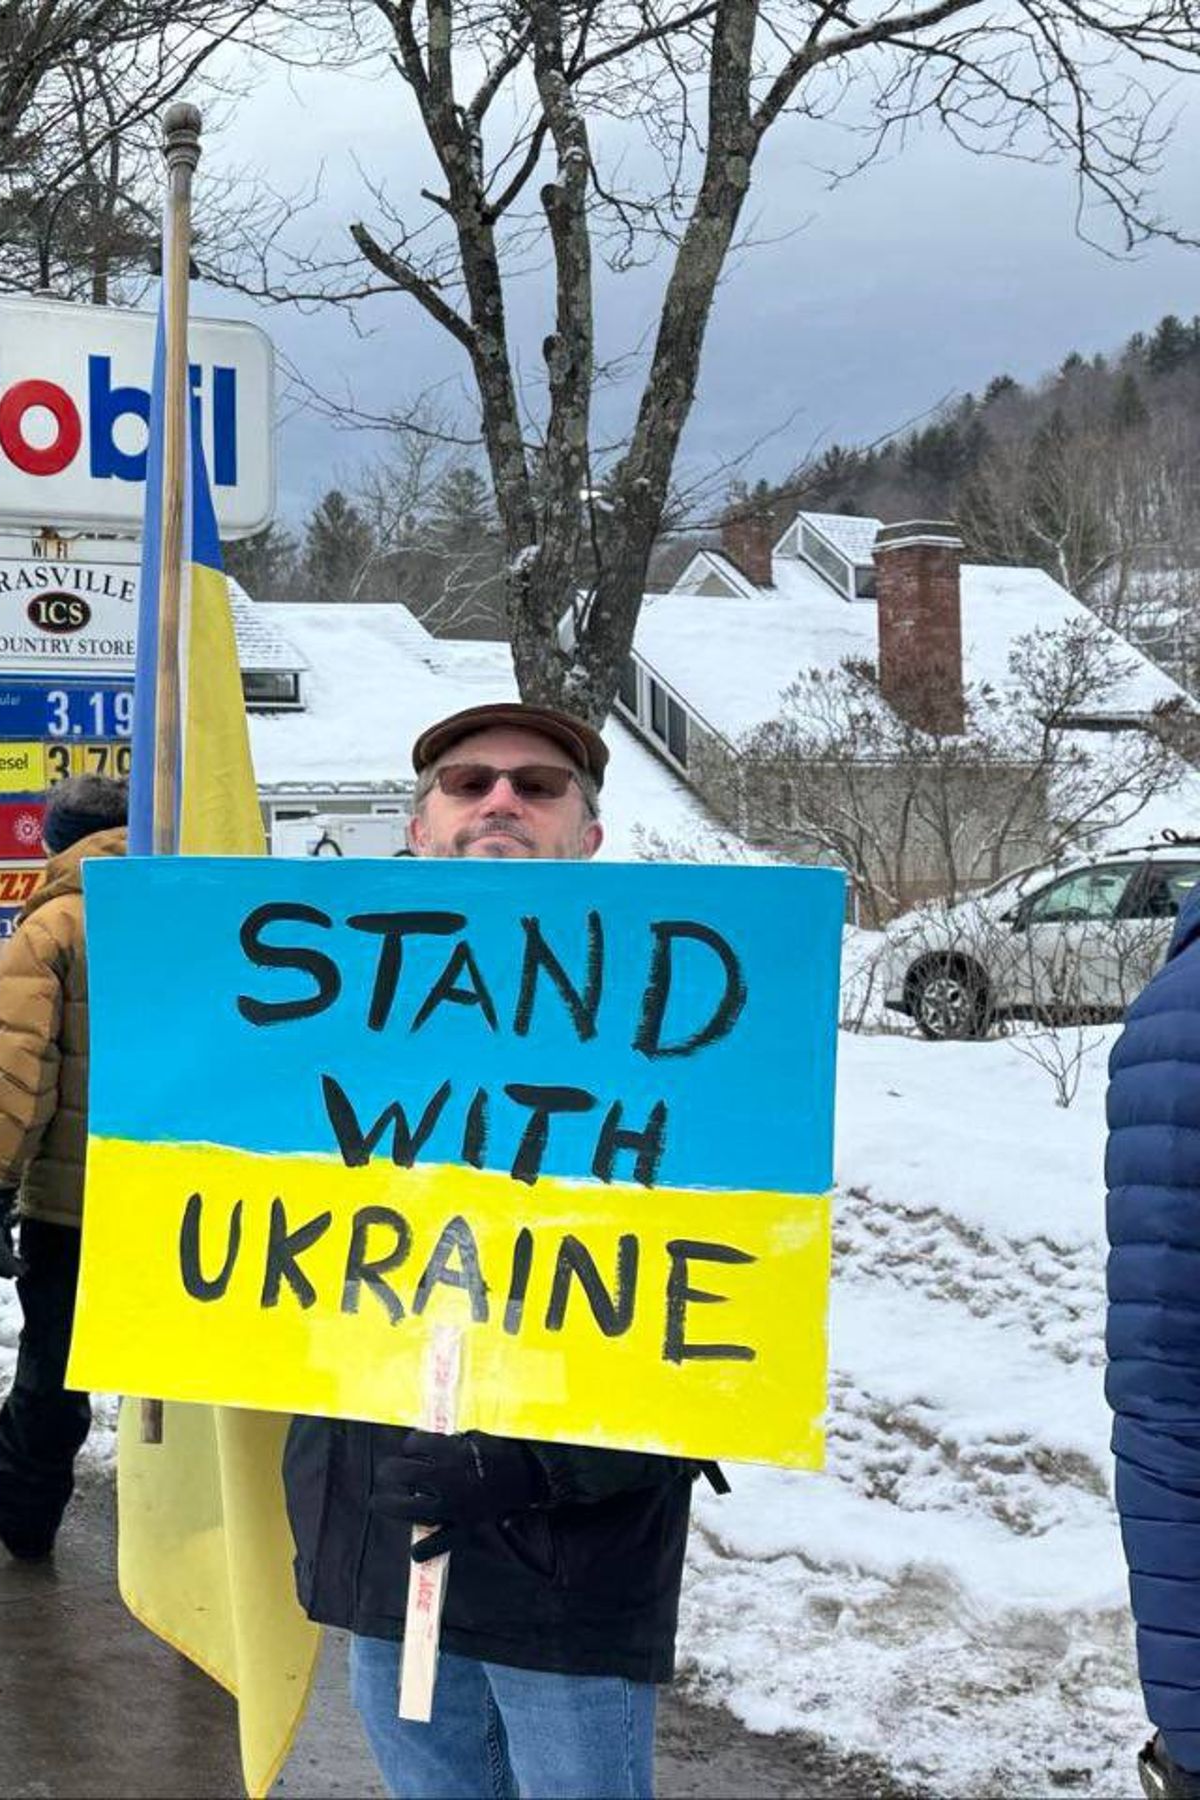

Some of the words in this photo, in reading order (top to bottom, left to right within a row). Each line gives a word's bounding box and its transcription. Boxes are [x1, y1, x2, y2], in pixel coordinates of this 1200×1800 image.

[37, 601, 84, 626] ICS
[74, 638, 136, 656] STORE
[47, 690, 135, 736] 3.19
[236, 901, 749, 1061] STAND
[320, 1073, 669, 1187] WITH
[178, 1192, 758, 1365] UKRAINE
